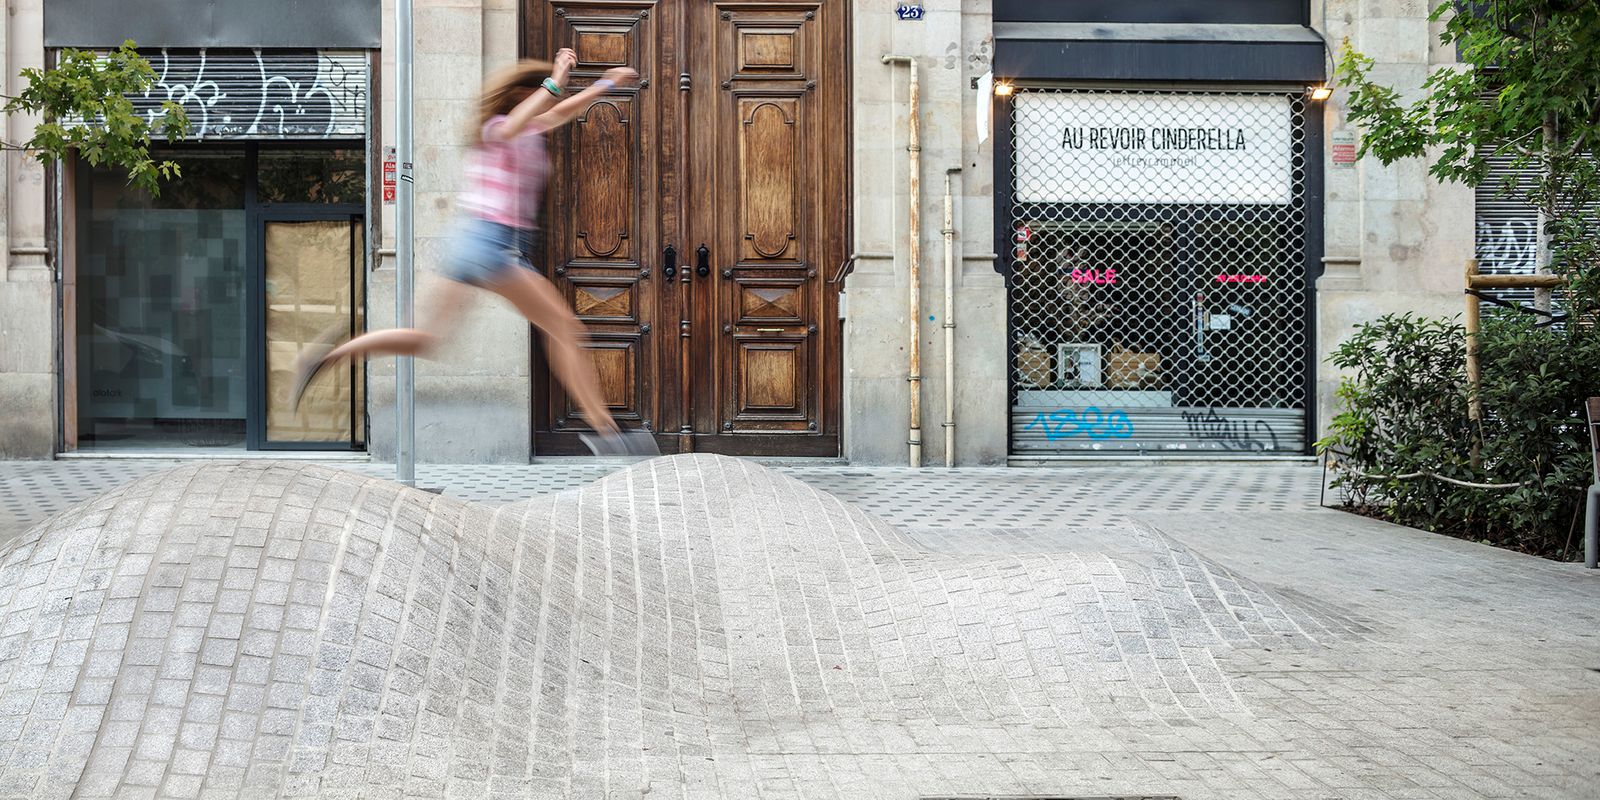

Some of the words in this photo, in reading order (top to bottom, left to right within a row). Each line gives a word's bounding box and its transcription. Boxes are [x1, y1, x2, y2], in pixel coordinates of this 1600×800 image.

[901, 5, 919, 18] 23
[1062, 127, 1083, 150] AU
[1089, 127, 1146, 150] REVOIR
[1151, 127, 1246, 150] CINDERELLA
[1071, 268, 1117, 284] SALE
